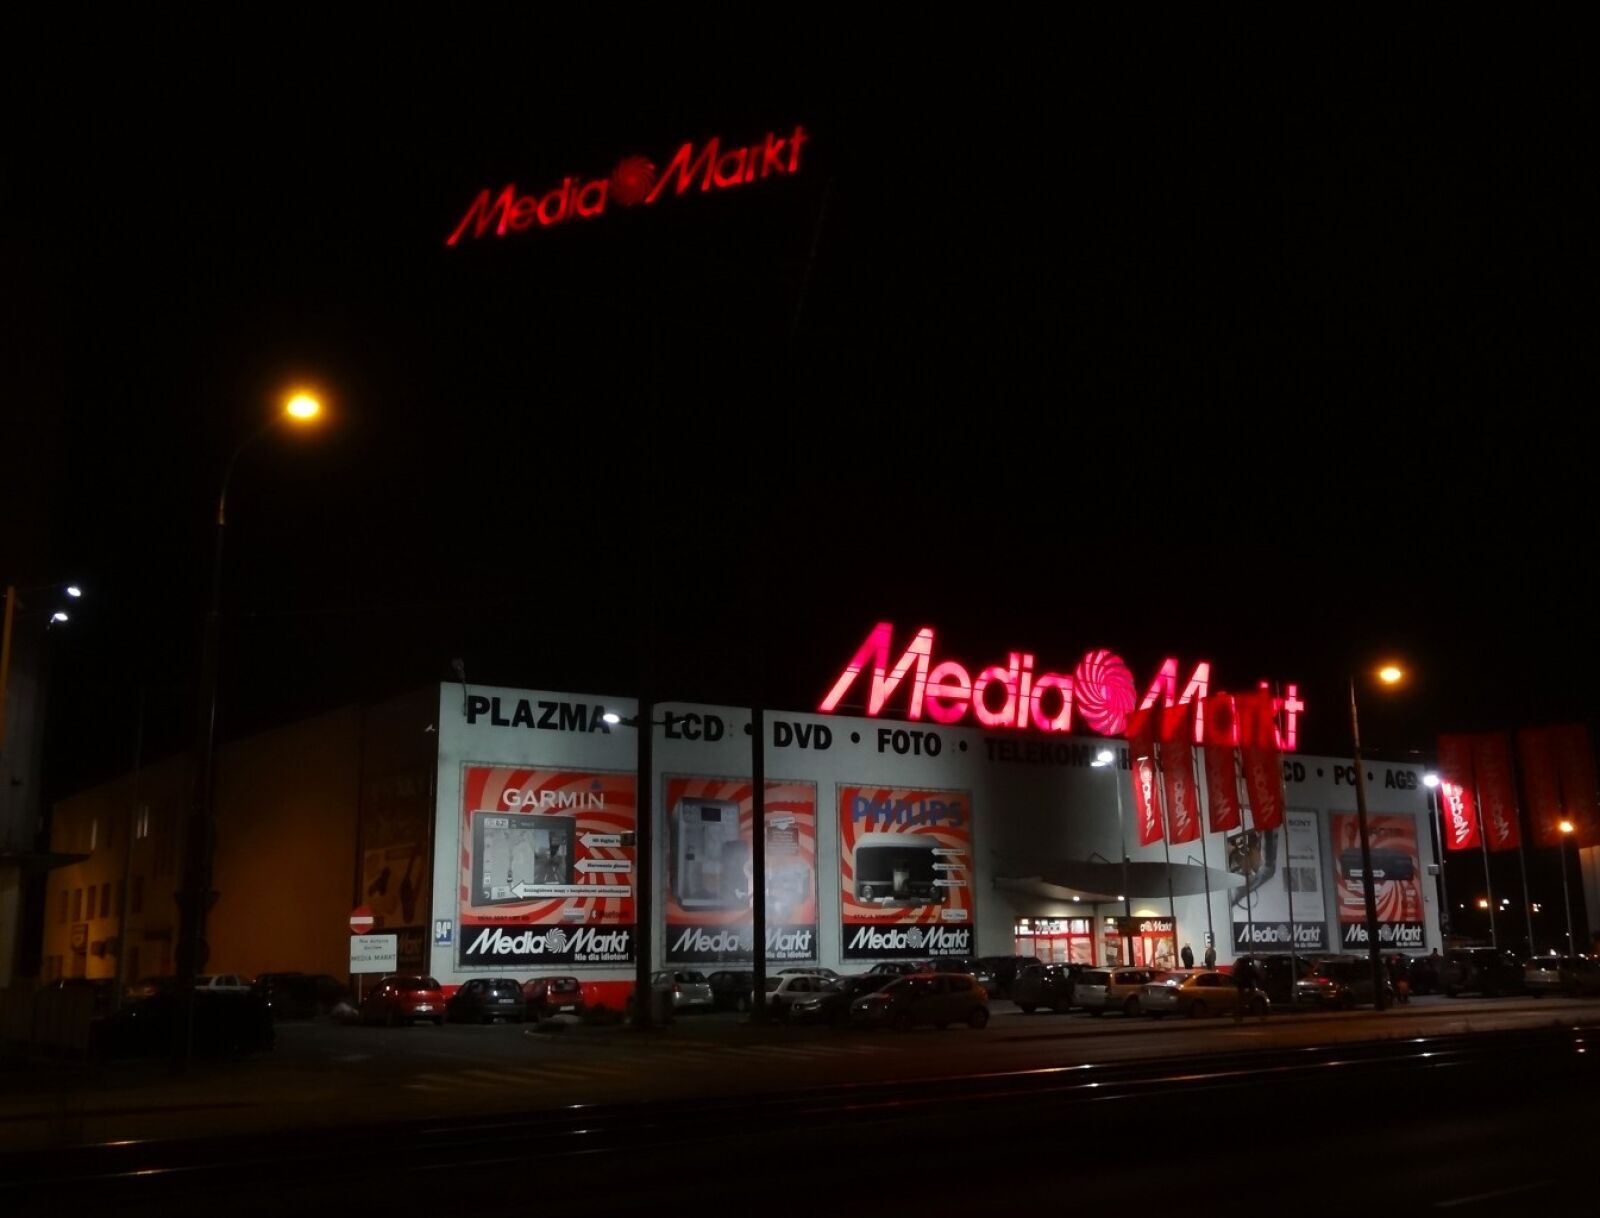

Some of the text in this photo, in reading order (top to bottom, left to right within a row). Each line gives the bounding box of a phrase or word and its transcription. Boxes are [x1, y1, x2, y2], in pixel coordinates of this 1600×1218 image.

[446, 125, 808, 246] Media Markt
[819, 622, 1074, 732] Media
[466, 695, 611, 735] PLAZMA
[664, 711, 724, 742] LCD
[773, 721, 833, 750] DVD
[877, 728, 942, 757] FOTO
[502, 787, 605, 810] GARMIN
[853, 795, 962, 827] PHILIPS
[466, 927, 630, 955] Media Markt
[671, 928, 741, 952] Media
[848, 926, 970, 949] Media Markt
[1238, 924, 1278, 943] Media
[1391, 923, 1422, 942] Markt
